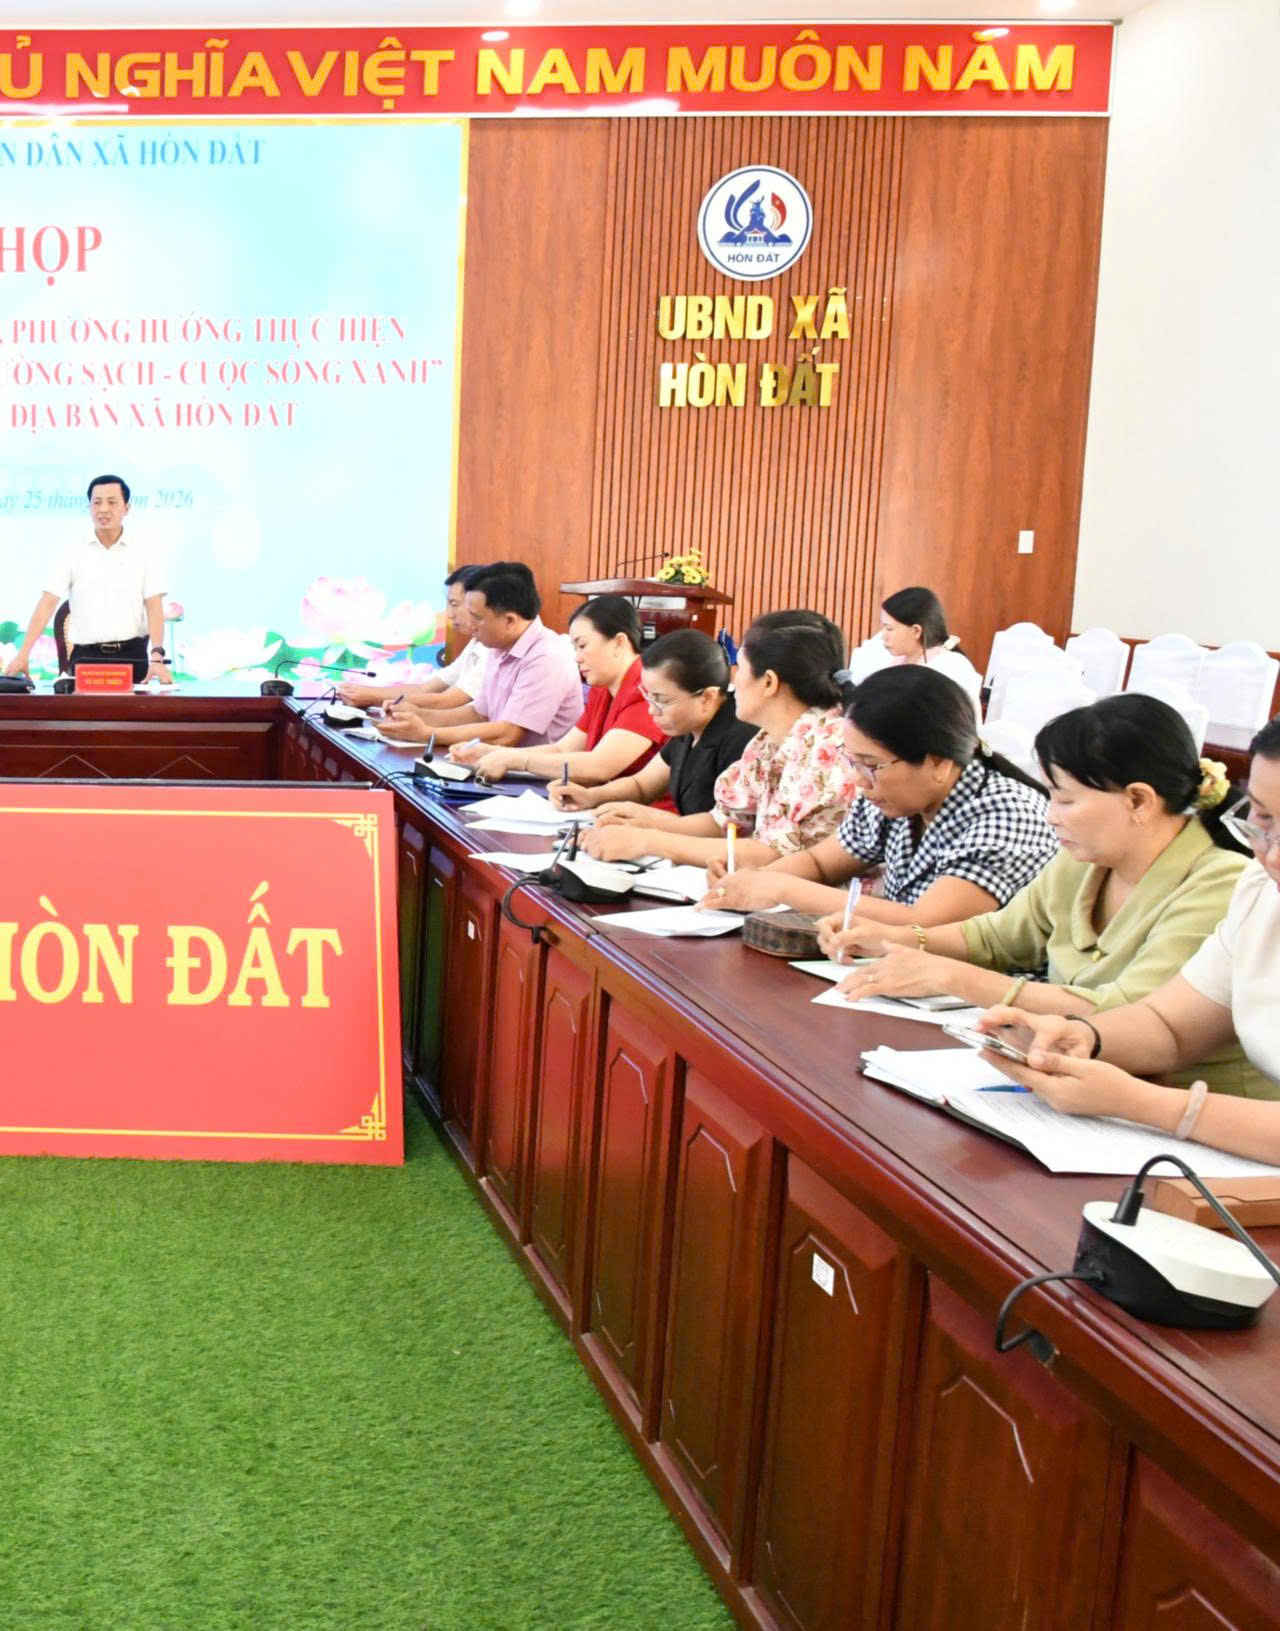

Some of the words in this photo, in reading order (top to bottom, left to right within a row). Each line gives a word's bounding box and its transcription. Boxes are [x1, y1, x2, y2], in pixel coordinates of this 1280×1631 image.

[65, 38, 282, 98] NGHĨA
[287, 37, 455, 109] VIỆT
[476, 47, 646, 95] NAM
[666, 29, 883, 93] MUÔN
[903, 29, 1075, 91] NĂM
[26, 132, 83, 167] DÂN
[92, 133, 130, 166] XÃ
[138, 131, 200, 167] HÒN
[658, 295, 774, 340] UBND
[789, 287, 850, 339] XÃ
[658, 352, 748, 408] HÒN
[759, 346, 841, 408] ĐẤT
[128, 397, 167, 428] XÃ
[165, 881, 344, 1009] ĐẤT
